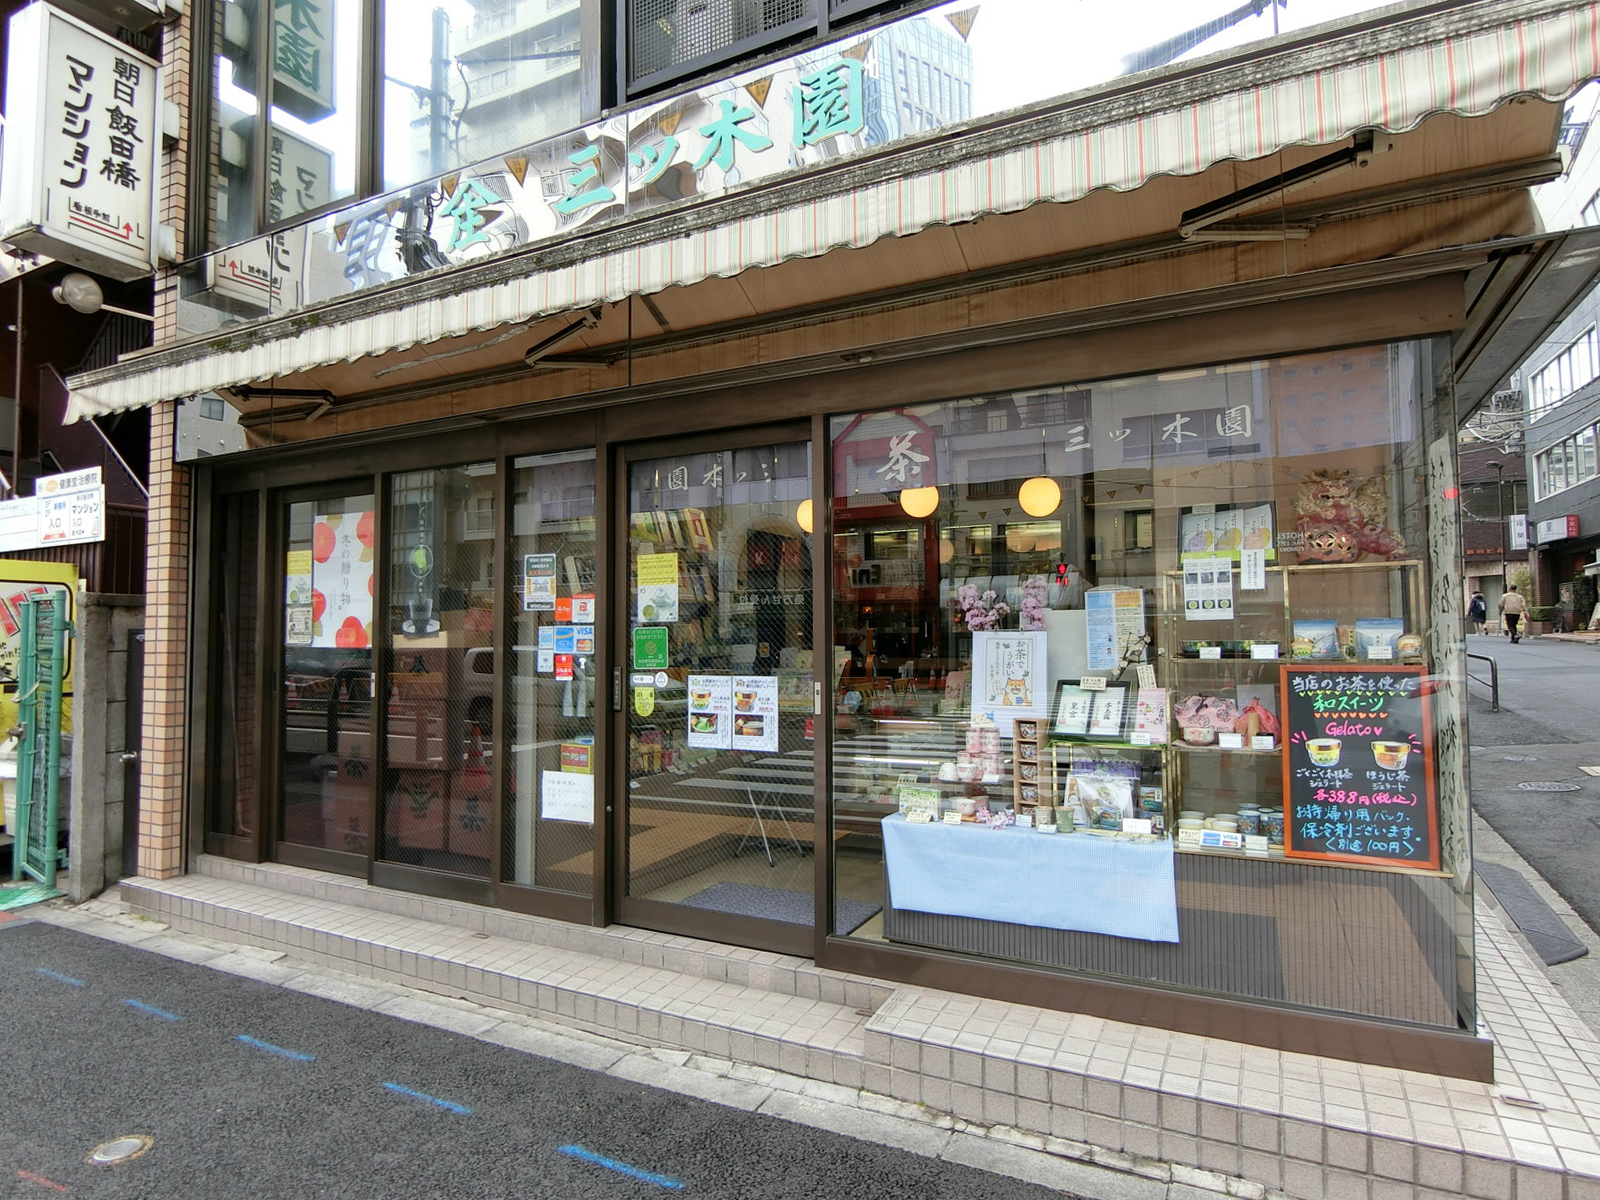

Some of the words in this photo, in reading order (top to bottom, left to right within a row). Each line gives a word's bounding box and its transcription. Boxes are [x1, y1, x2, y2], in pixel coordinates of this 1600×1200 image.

[59, 54, 95, 190] マンション
[100, 55, 144, 191] 朝日飯田橋
[1064, 404, 1253, 452] 三ツ木園
[874, 429, 931, 484] 茶
[71, 502, 99, 515] マンション
[577, 627, 593, 636] VISA
[1014, 640, 1026, 669] お茶で
[1005, 651, 1015, 676] うがい
[1293, 675, 1417, 692] 当店のお茶を使った
[1313, 694, 1384, 712] 和スイーツ
[1325, 720, 1371, 736] Gelato
[1309, 779, 1343, 788] ジェラート
[1366, 770, 1411, 782] ほうじ茶
[1372, 782, 1406, 792] ジェラート
